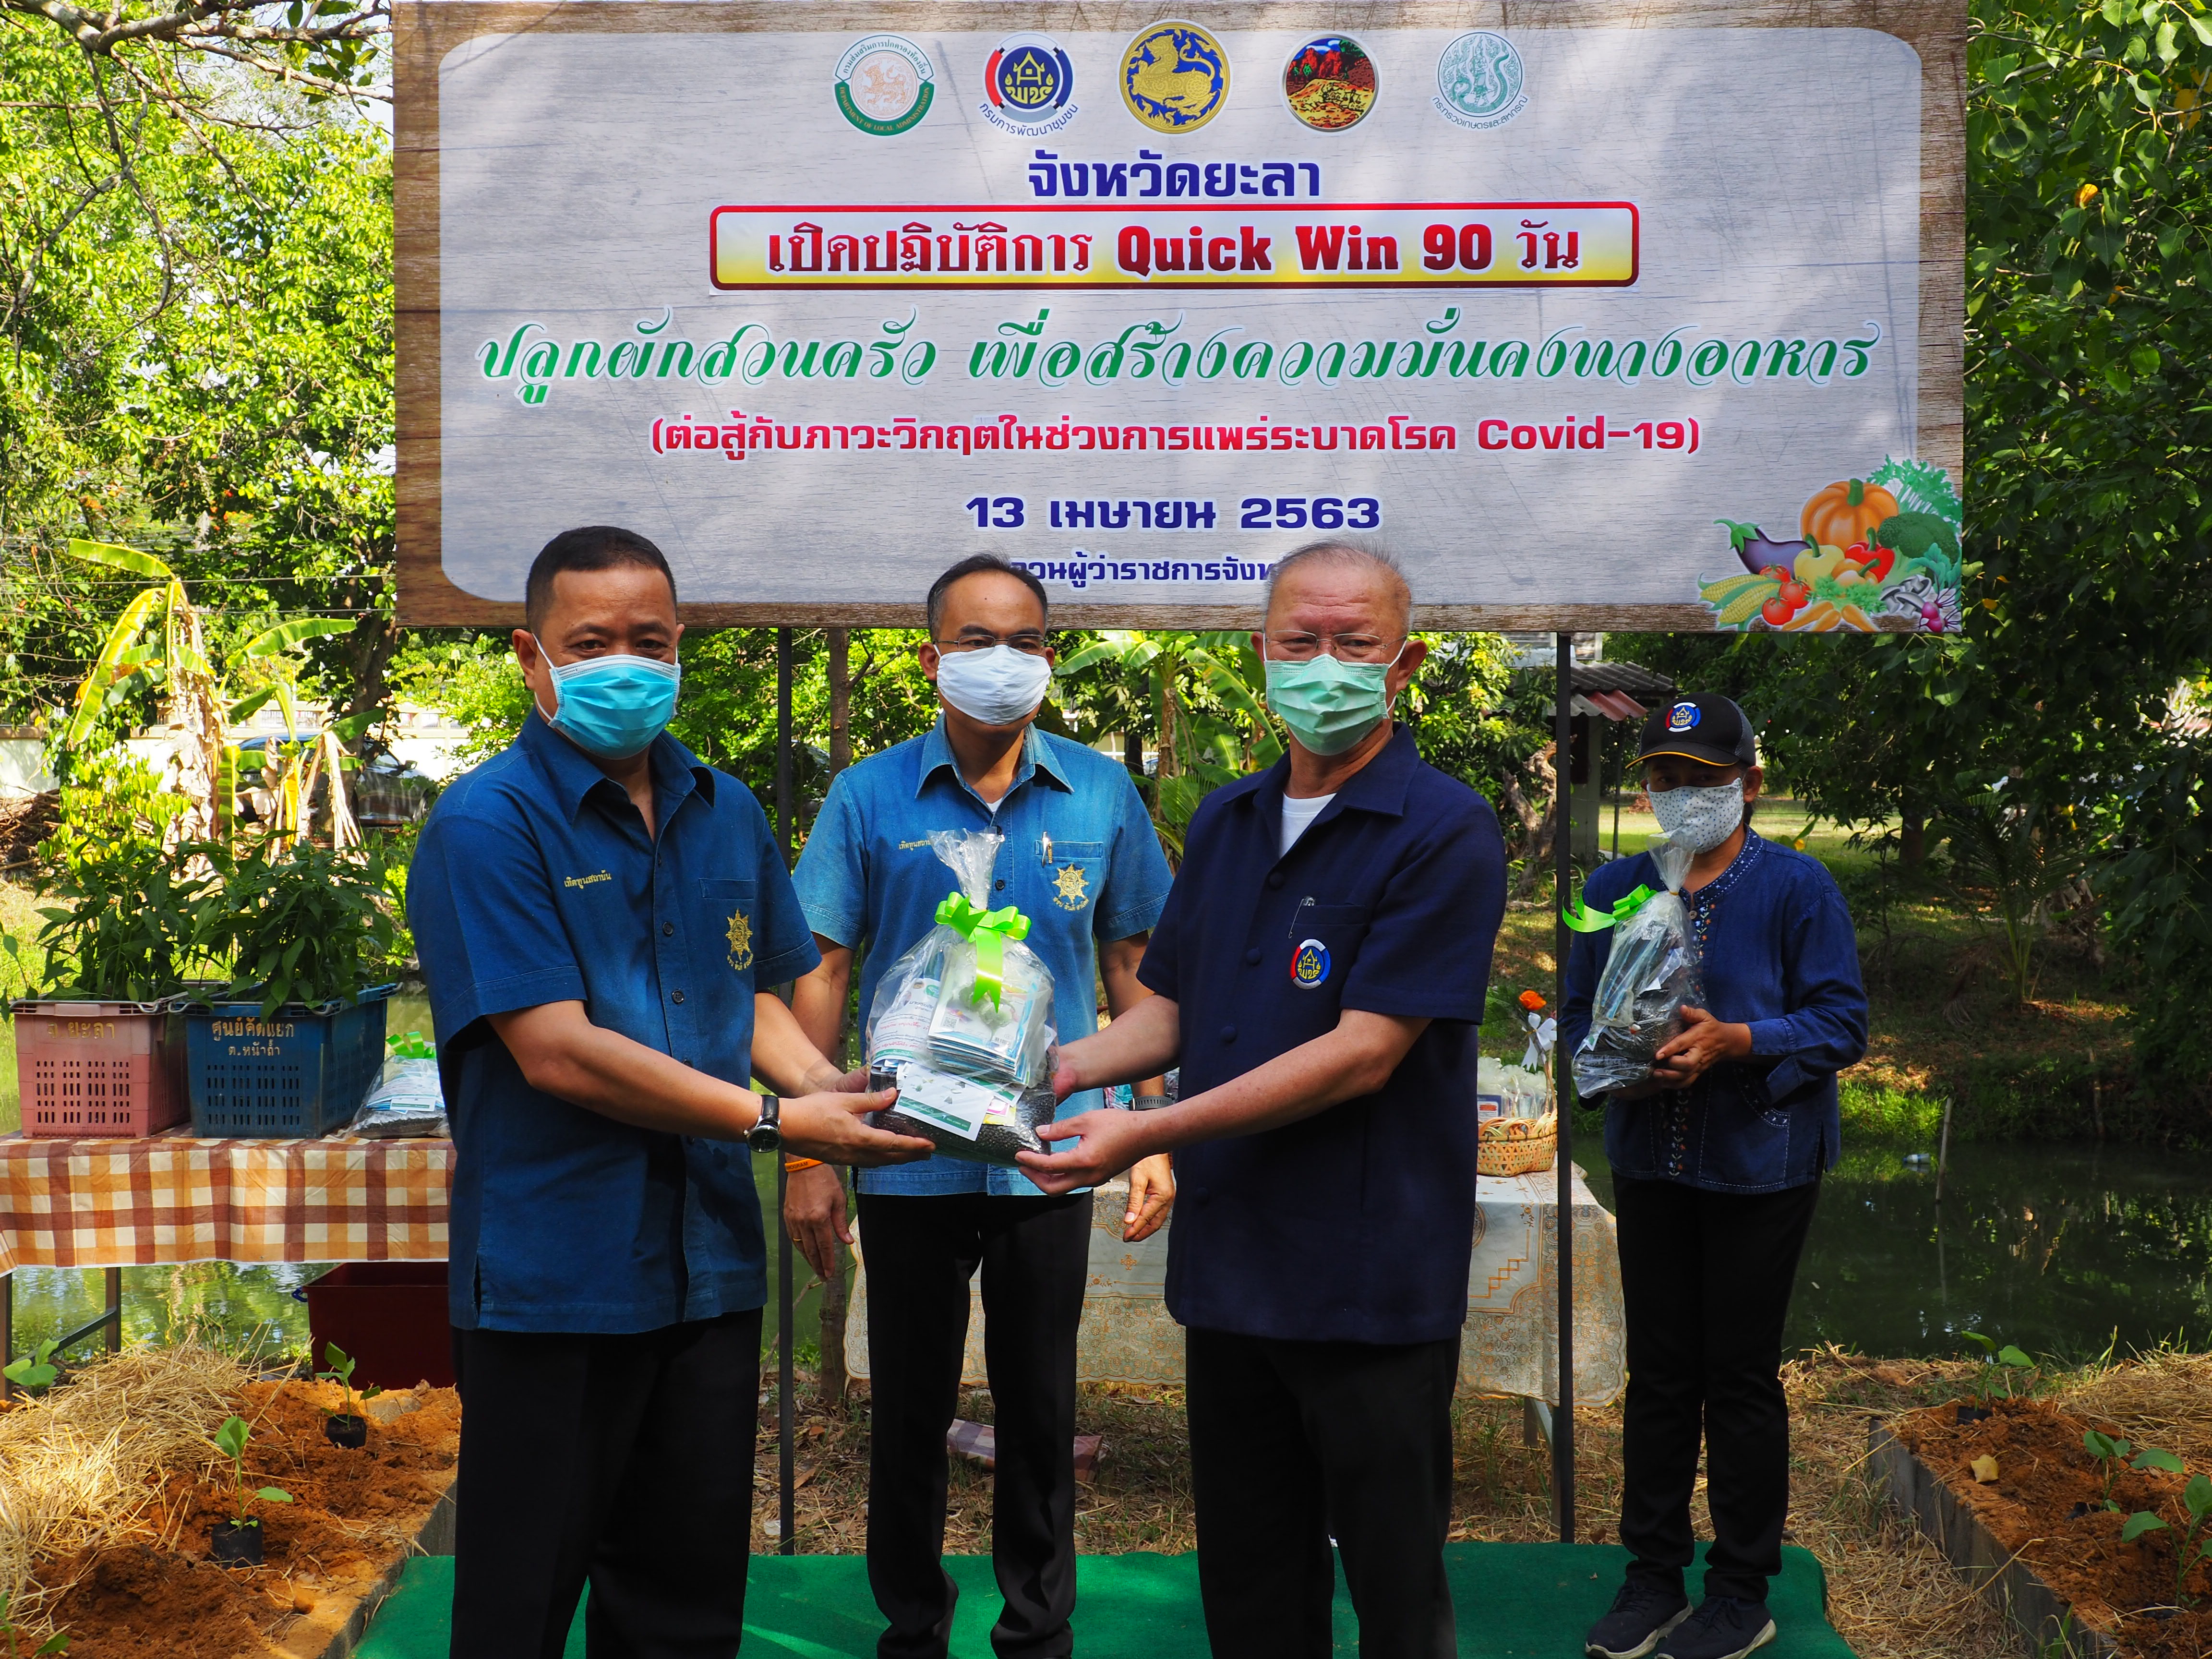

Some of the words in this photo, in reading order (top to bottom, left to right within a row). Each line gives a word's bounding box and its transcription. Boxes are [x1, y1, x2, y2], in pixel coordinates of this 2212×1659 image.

[840, 86, 863, 124] DEPARTMENT
[895, 87, 930, 129] ADMINISTRATION
[979, 103, 1078, 136] กรมการพัฒนาชุมชน
[1432, 95, 1528, 129] กระทรวงเกษตรและสหกรณ์
[1029, 149, 1320, 197] จังหวัดยะลา
[769, 221, 1093, 272] เปิดปฏิบัติการ
[1118, 226, 1271, 276] Quick
[1295, 225, 1398, 270] Win
[1423, 224, 1492, 270] 90
[1516, 219, 1579, 268] วัน
[479, 307, 937, 404] ปลูกผักสวนครัว
[969, 307, 1881, 386] เพื่อสร้างความมั่นคงทางอาหาร
[652, 410, 1456, 460] (ต่อสู้กับภาวะวิกฤตในช่วงการแพร่ระบาดโรค
[1478, 415, 1700, 454] Covid-19)
[966, 497, 1024, 528] 13
[1050, 501, 1216, 529] เมษายน
[1240, 498, 1380, 529] 2563
